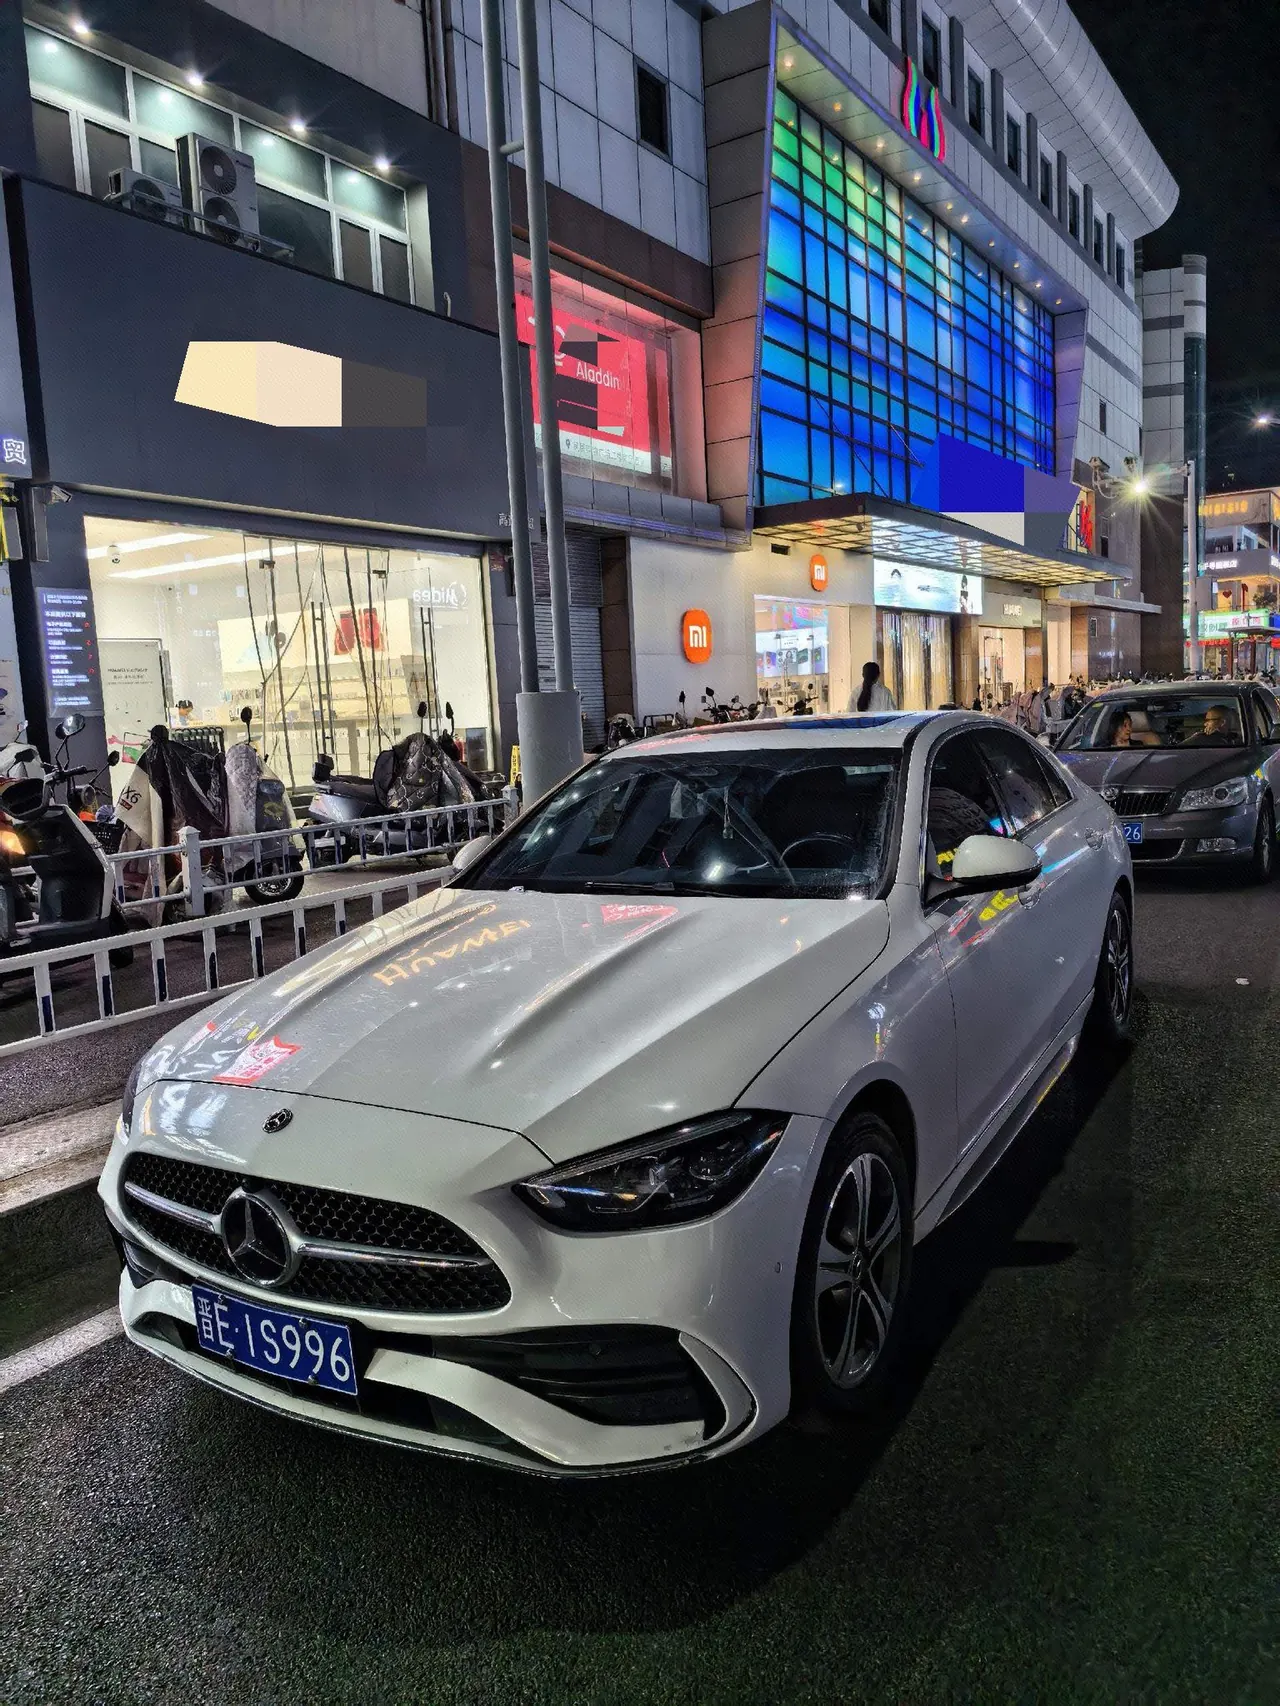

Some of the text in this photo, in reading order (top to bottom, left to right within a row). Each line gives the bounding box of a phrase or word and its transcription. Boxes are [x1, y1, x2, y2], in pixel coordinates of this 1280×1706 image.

[576, 361, 620, 389] Aladdin
[3, 439, 26, 465] 贸
[1124, 826, 1141, 841] 26
